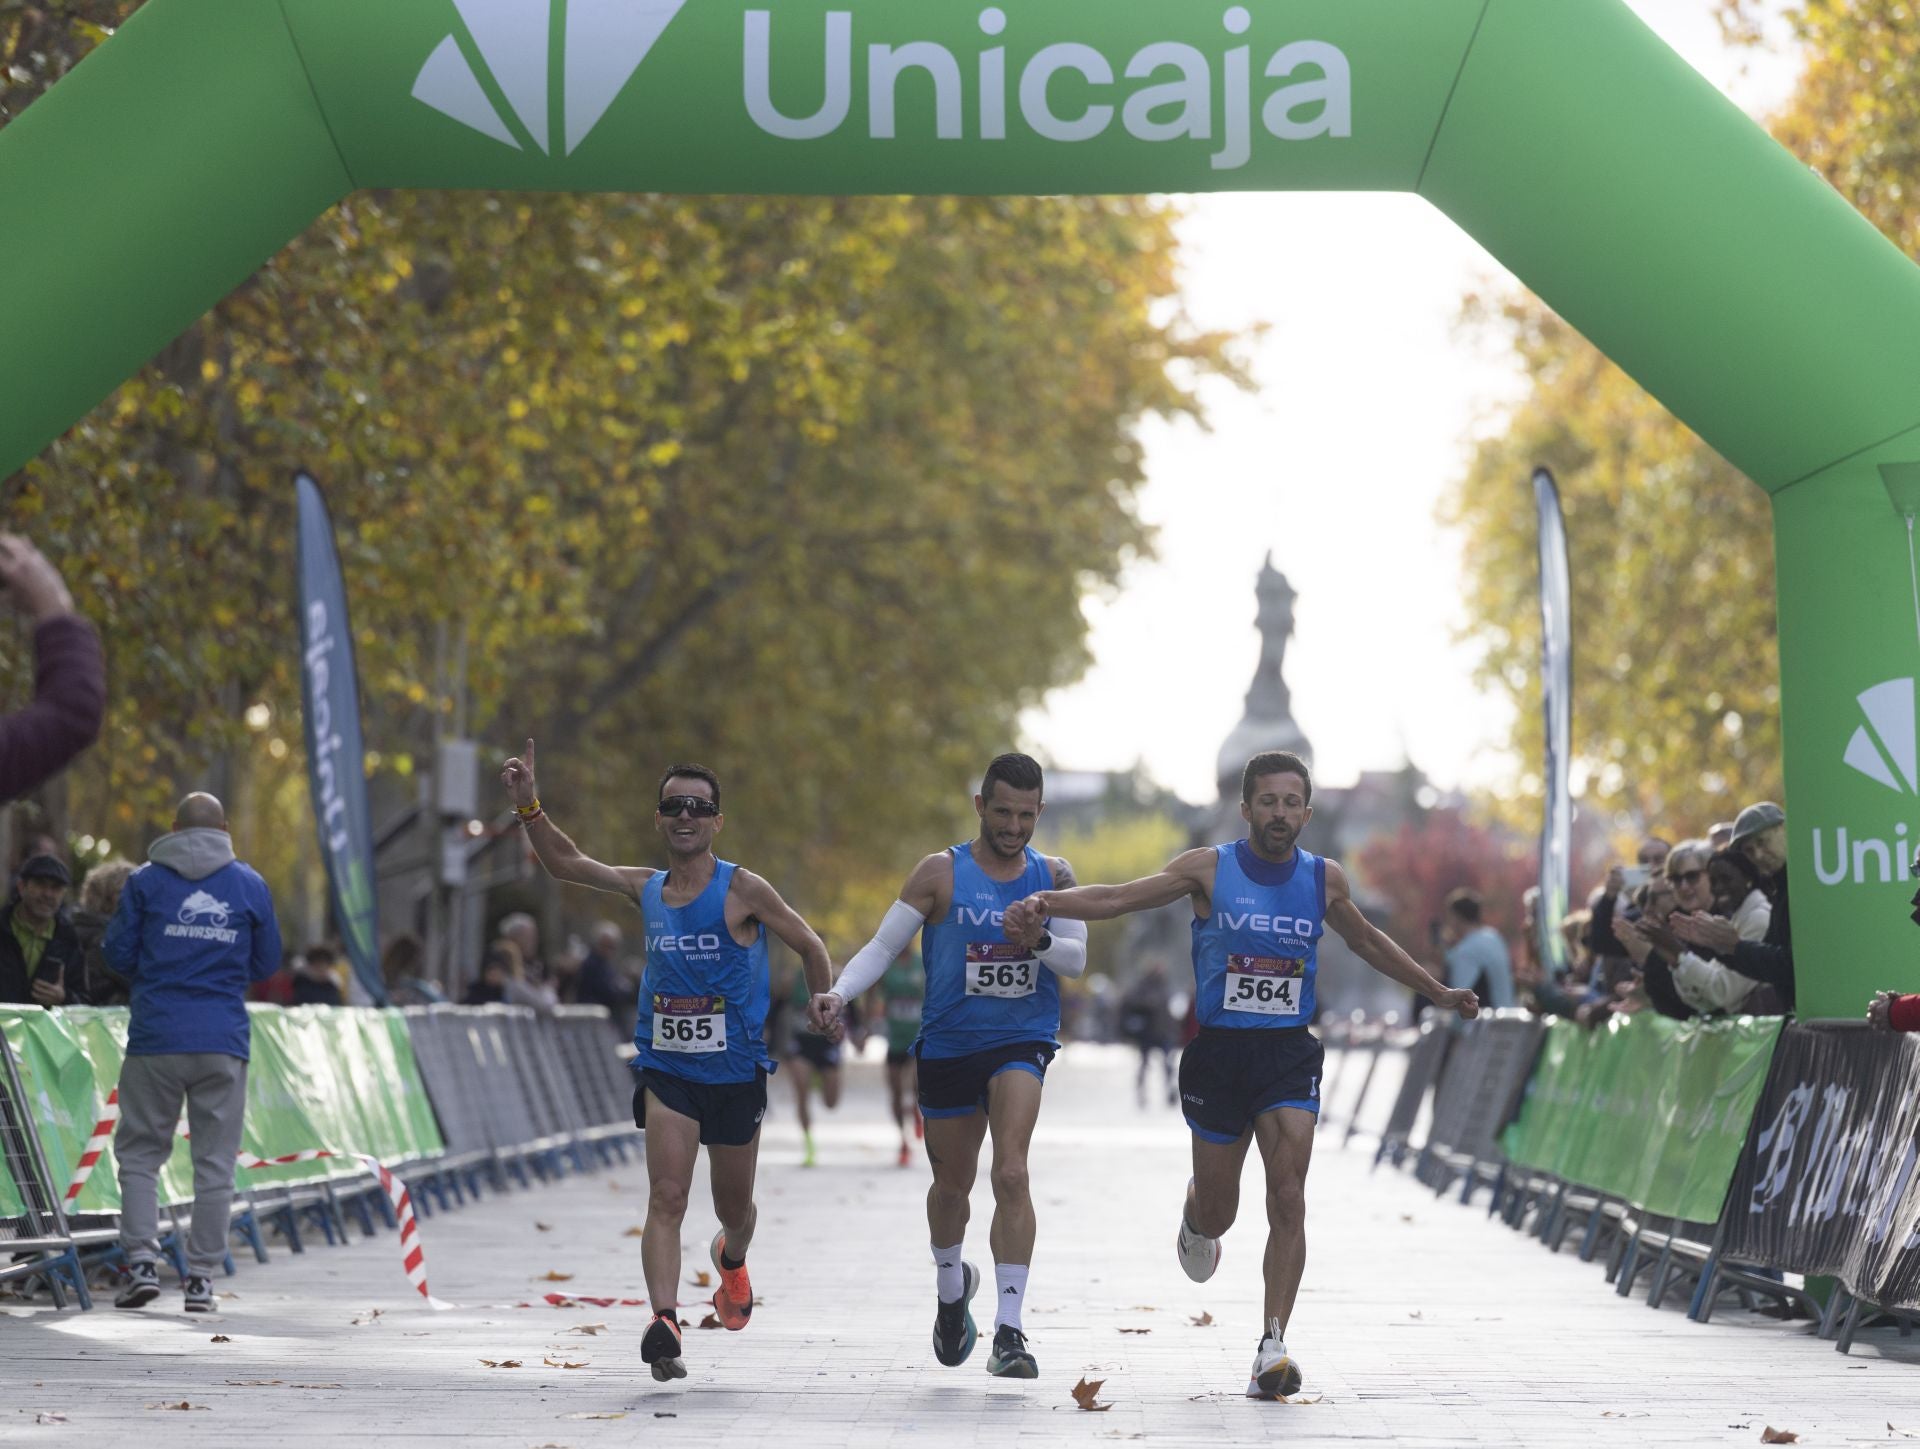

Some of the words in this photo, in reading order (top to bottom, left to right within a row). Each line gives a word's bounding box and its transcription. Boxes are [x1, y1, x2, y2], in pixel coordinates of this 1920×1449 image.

[743, 5, 1351, 170] Unicaja
[1812, 822, 1920, 885] Uni
[957, 907, 1004, 927] IVE
[1217, 912, 1313, 937] IVECO
[645, 934, 720, 952] IVECO
[686, 951, 721, 961] running
[977, 964, 1030, 988] 563
[1236, 977, 1290, 1003] 564
[661, 1017, 713, 1042] 565
